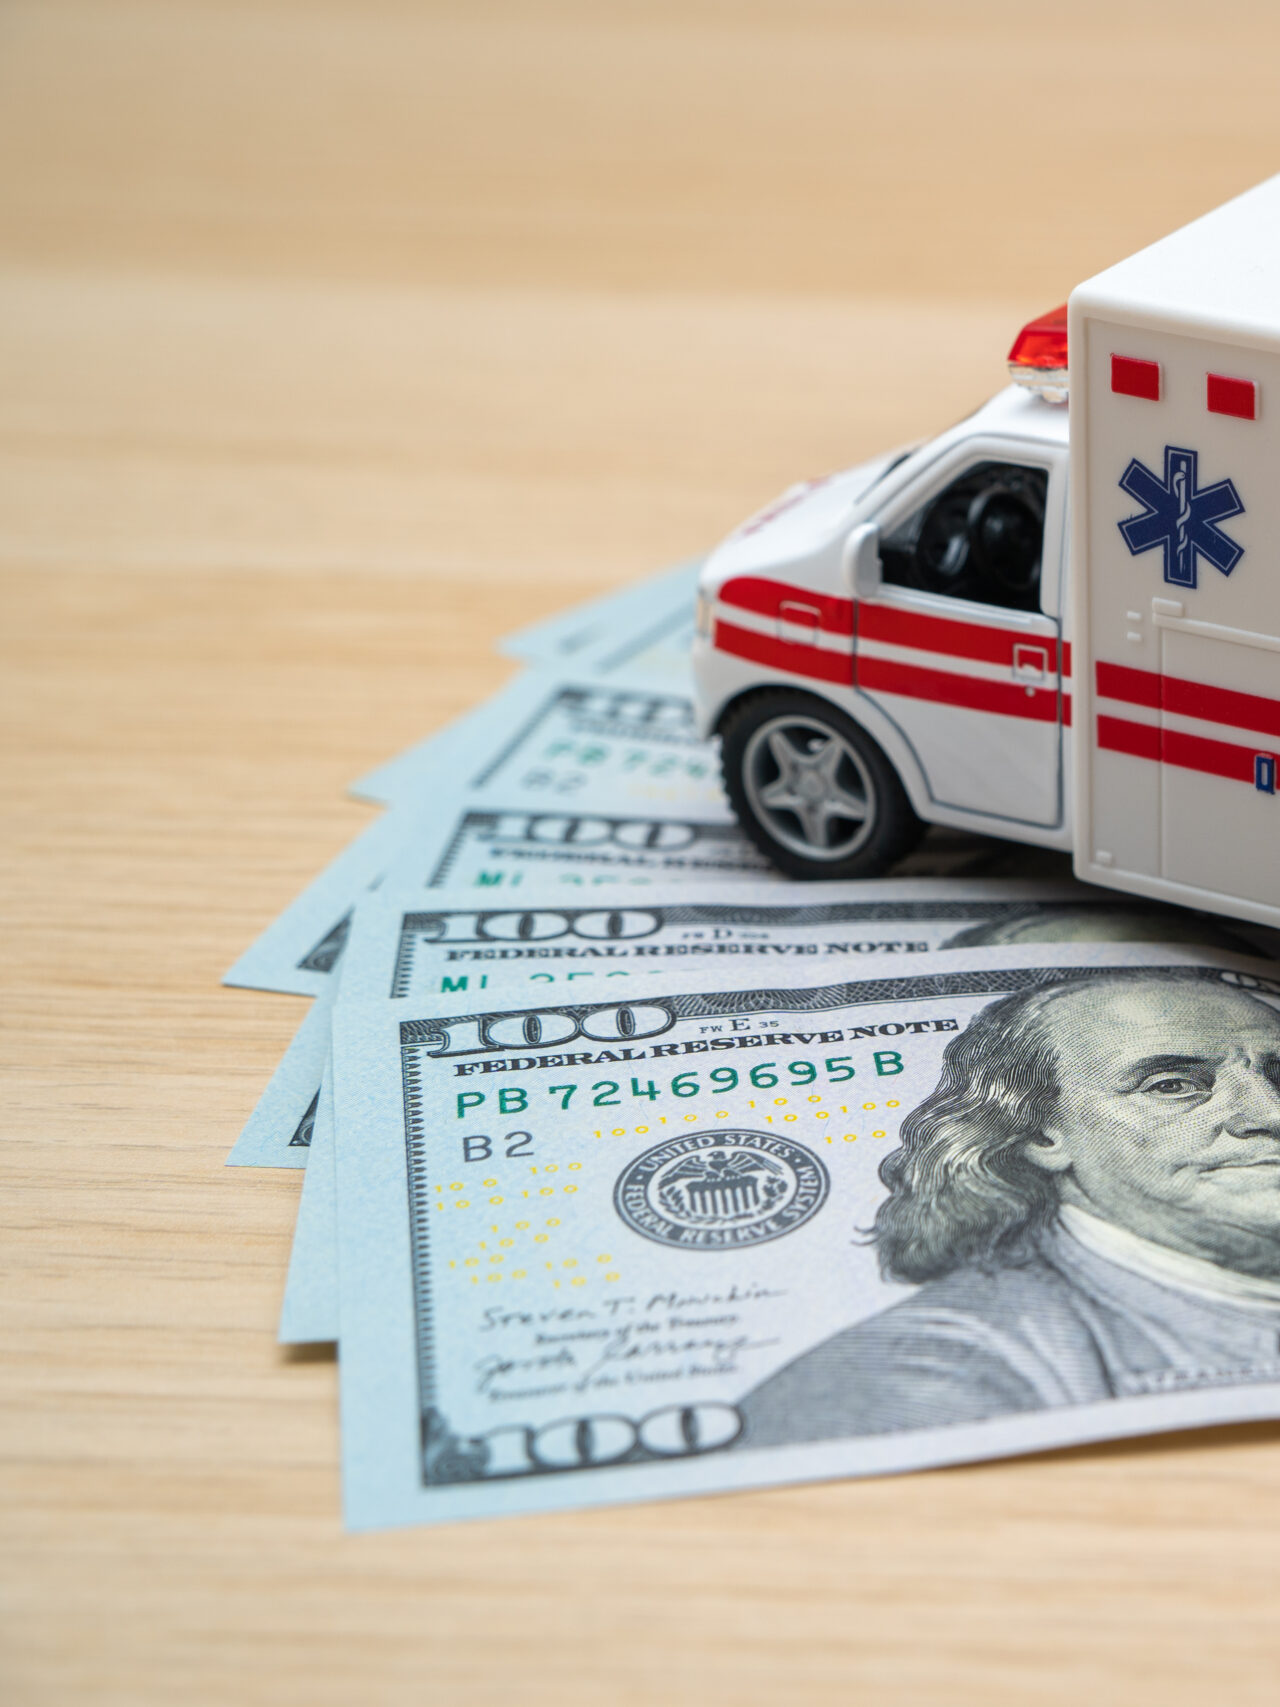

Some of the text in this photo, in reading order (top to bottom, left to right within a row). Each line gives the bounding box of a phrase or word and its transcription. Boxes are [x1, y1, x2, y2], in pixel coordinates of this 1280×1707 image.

[474, 814, 698, 852] 100
[424, 909, 664, 946] 100
[446, 940, 929, 963] FEDERAL RESERVE NOTE
[427, 1002, 677, 1060] 100
[700, 1017, 780, 1035] FW E 35
[453, 1017, 960, 1078] FEDERAL RESERVE NOTE
[462, 1131, 535, 1164] B2
[639, 1133, 796, 1173] UNITED STATES
[781, 1164, 820, 1221] SYSTEM
[625, 1183, 784, 1246] FEDERAL RESERVE
[472, 1400, 747, 1475] 100
